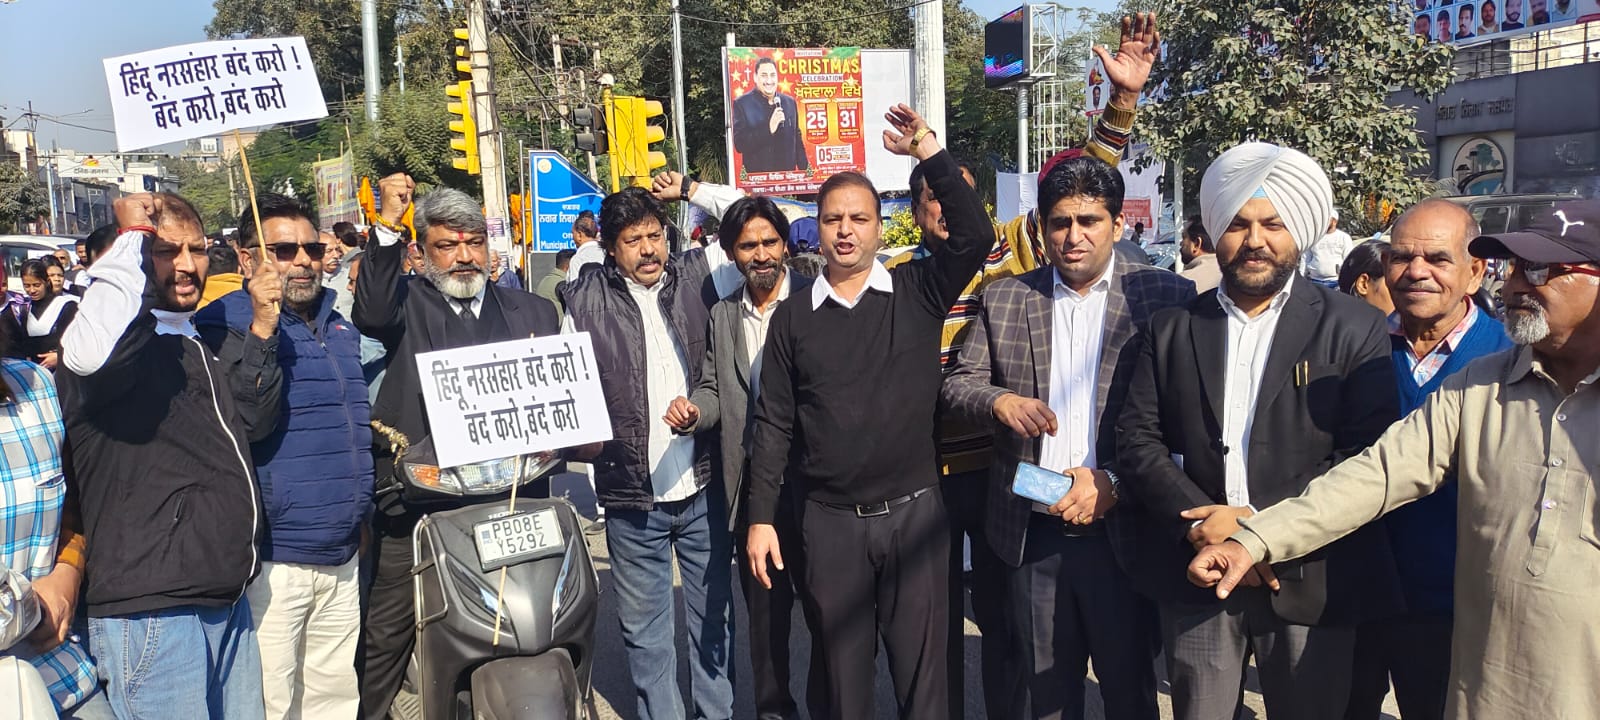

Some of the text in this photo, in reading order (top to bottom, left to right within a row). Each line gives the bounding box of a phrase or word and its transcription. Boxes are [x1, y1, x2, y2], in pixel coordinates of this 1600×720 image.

[119, 43, 302, 101] हिंदू नरसंहार बंद करो !
[778, 58, 860, 75] CHRISTMAS
[152, 94, 182, 130] बंद
[251, 77, 287, 111] करो
[806, 110, 857, 129] 25 31
[818, 148, 833, 162] 05
[540, 240, 569, 250] Municipal
[431, 342, 590, 411] हिंदू नरसंहार बंद करो !
[464, 404, 492, 446] बंद
[549, 389, 580, 432] करो
[491, 514, 543, 539] PB08E
[496, 531, 547, 556] Y5292
